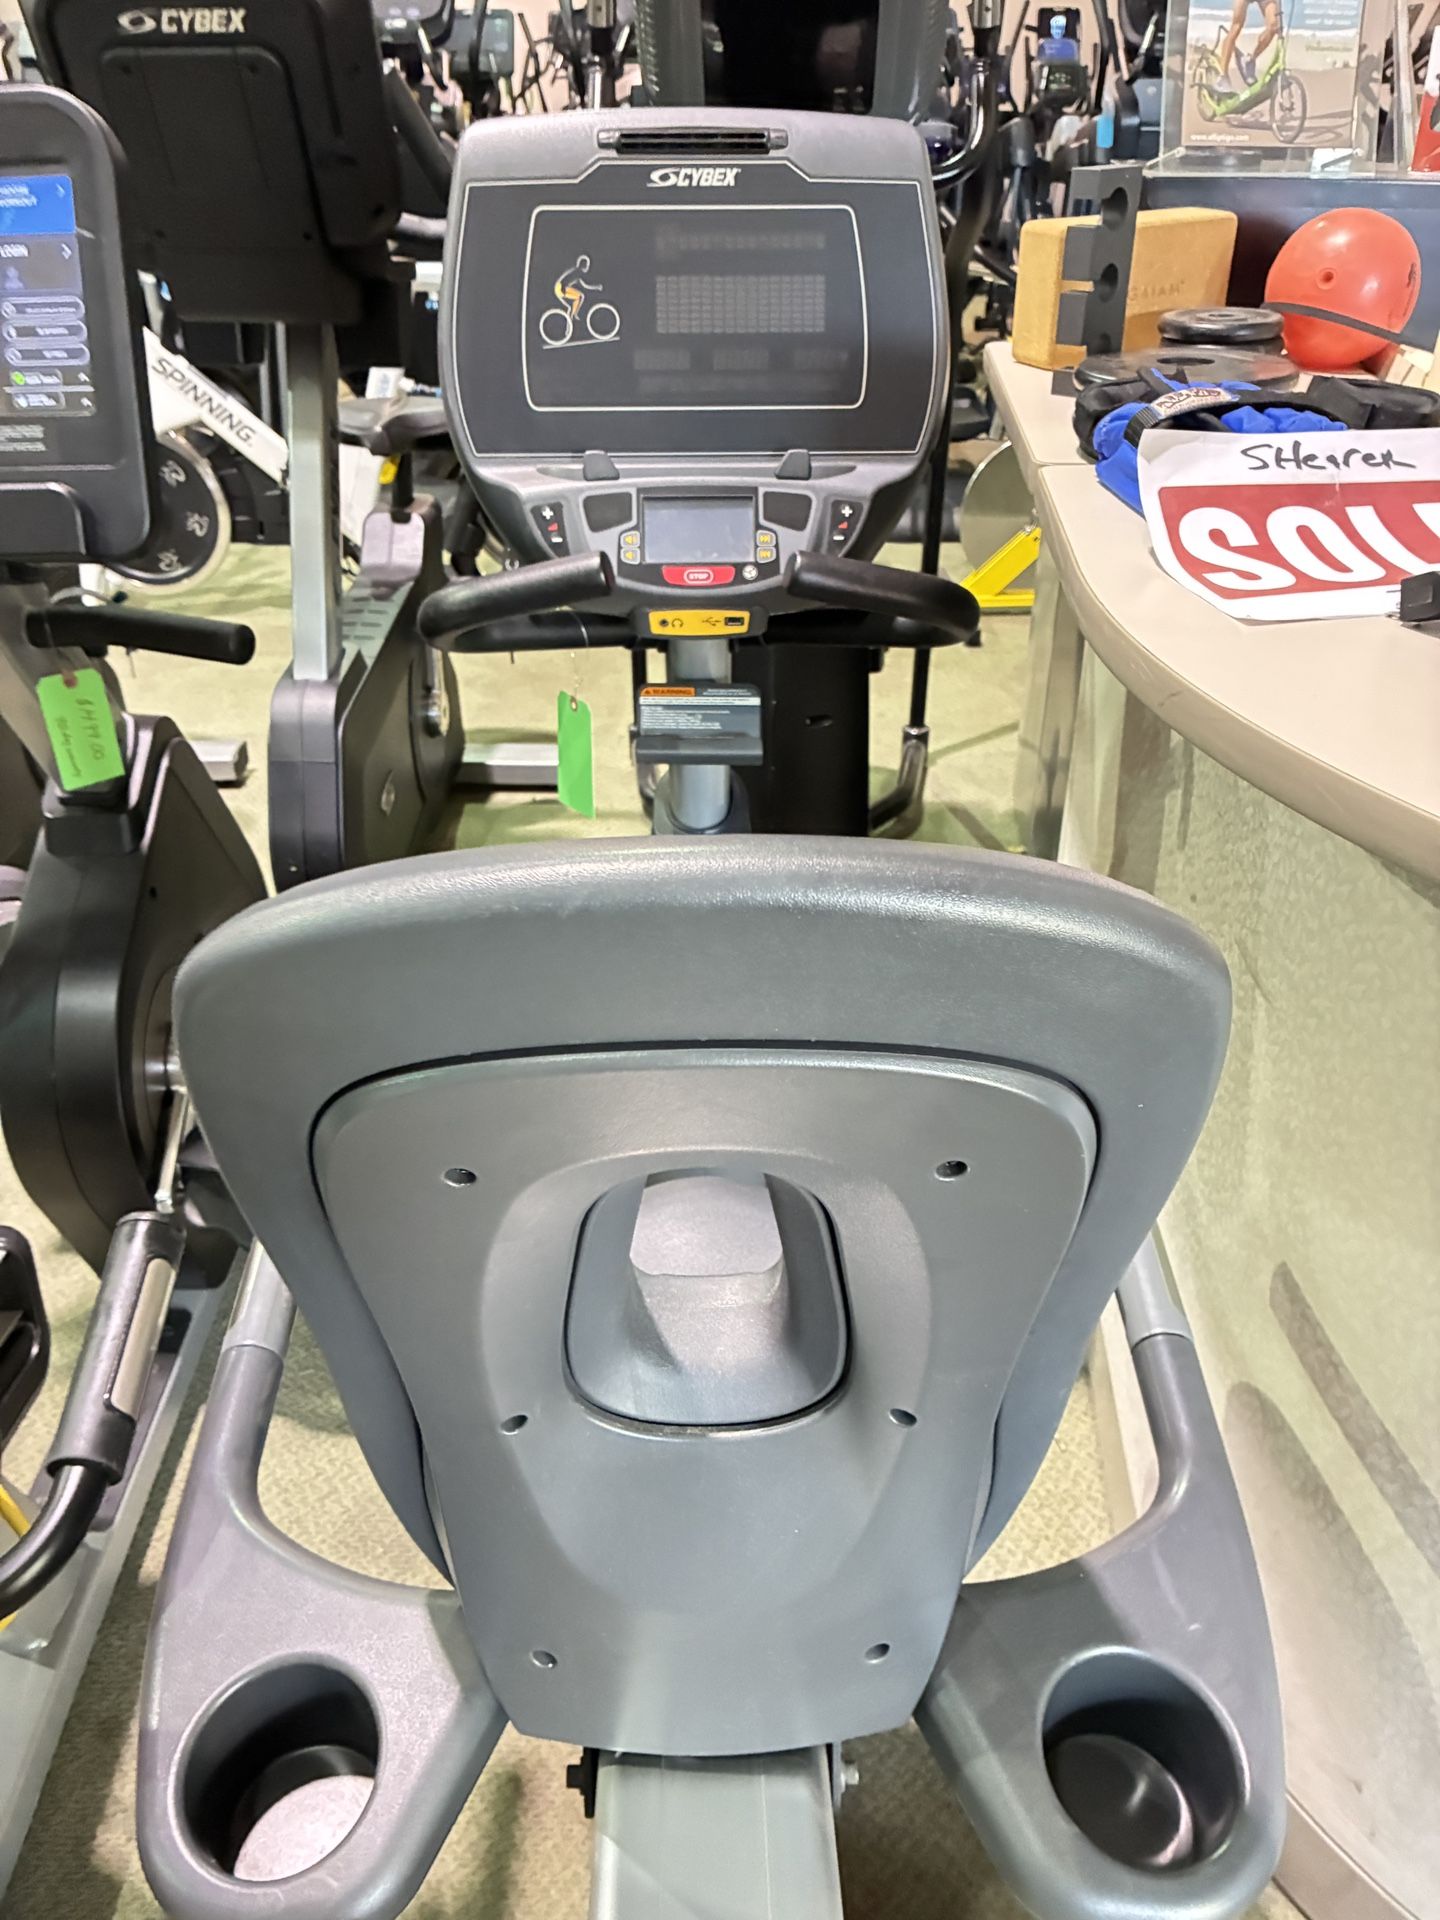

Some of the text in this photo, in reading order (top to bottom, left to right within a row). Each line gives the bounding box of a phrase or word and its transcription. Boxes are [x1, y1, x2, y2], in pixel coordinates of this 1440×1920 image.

[161, 7, 246, 34] CYBEX
[677, 167, 738, 187] CYBEX
[152, 357, 256, 445] SPINNING
[651, 688, 692, 696] WARNING
